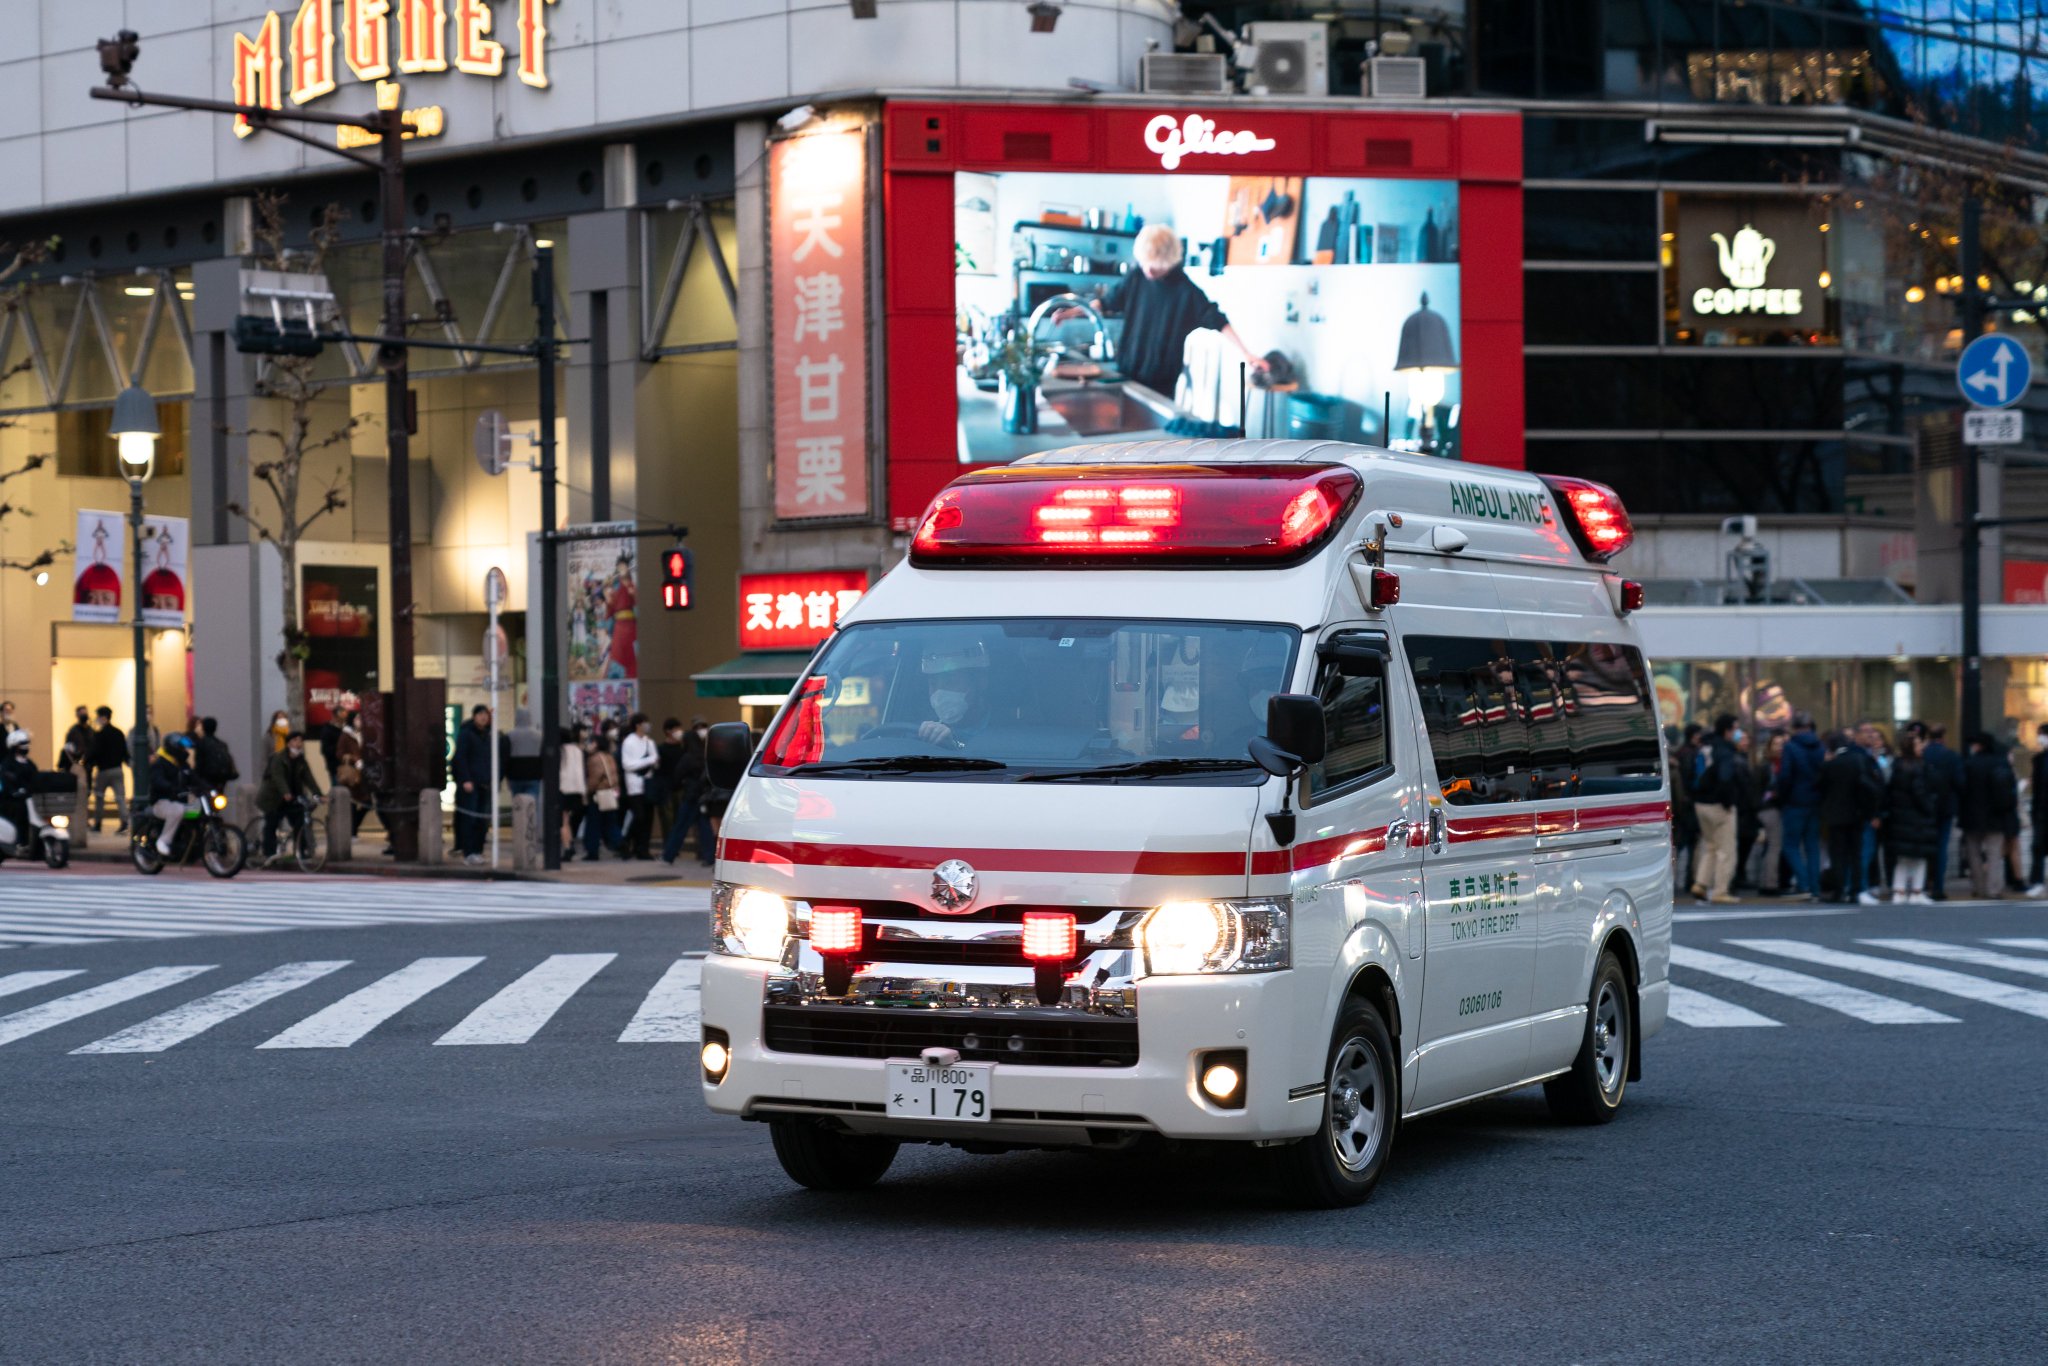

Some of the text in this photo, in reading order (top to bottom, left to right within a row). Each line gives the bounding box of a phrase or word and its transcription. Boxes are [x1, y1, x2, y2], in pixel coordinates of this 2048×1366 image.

[1144, 114, 1276, 170] Glico
[1693, 287, 1802, 315] COFFEE
[1450, 480, 1552, 524] AMBULANCE
[1449, 871, 1519, 915] 東京消防庁
[1451, 912, 1520, 940] TOKYO FIRE DEPT.
[1459, 990, 1502, 1016] 03060106
